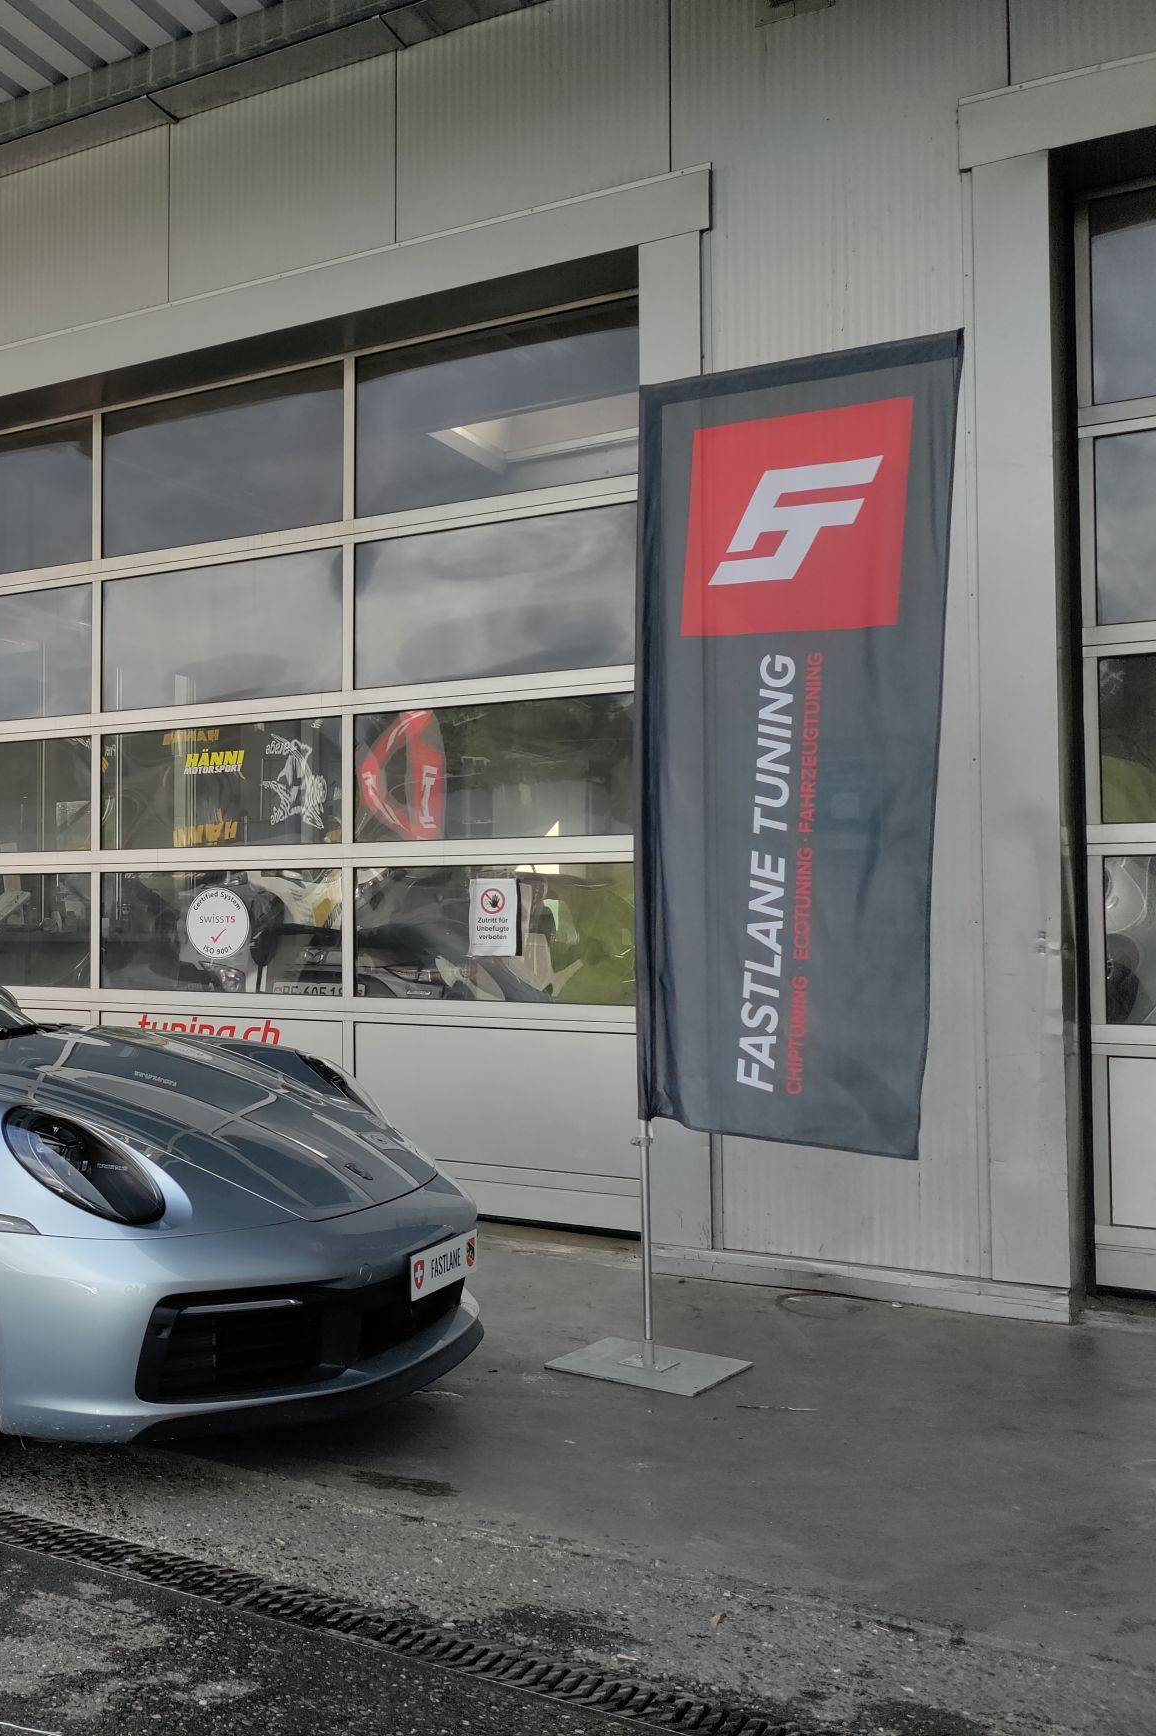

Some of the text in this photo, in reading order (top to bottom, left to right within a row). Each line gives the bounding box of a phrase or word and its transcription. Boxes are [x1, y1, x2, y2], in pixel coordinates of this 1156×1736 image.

[185, 749, 245, 768] HÄNNI
[183, 763, 243, 775] MOTORSPORT
[736, 654, 796, 1092] FASTLANE TUNING
[785, 652, 824, 1095] CHIPTUNING ECOTUNING FAHRZEUGTUNING
[193, 891, 241, 911] Certified System
[476, 925, 509, 933] Unbefugte
[202, 944, 232, 955] ISO 9001
[430, 1247, 461, 1279] FASTLANE
